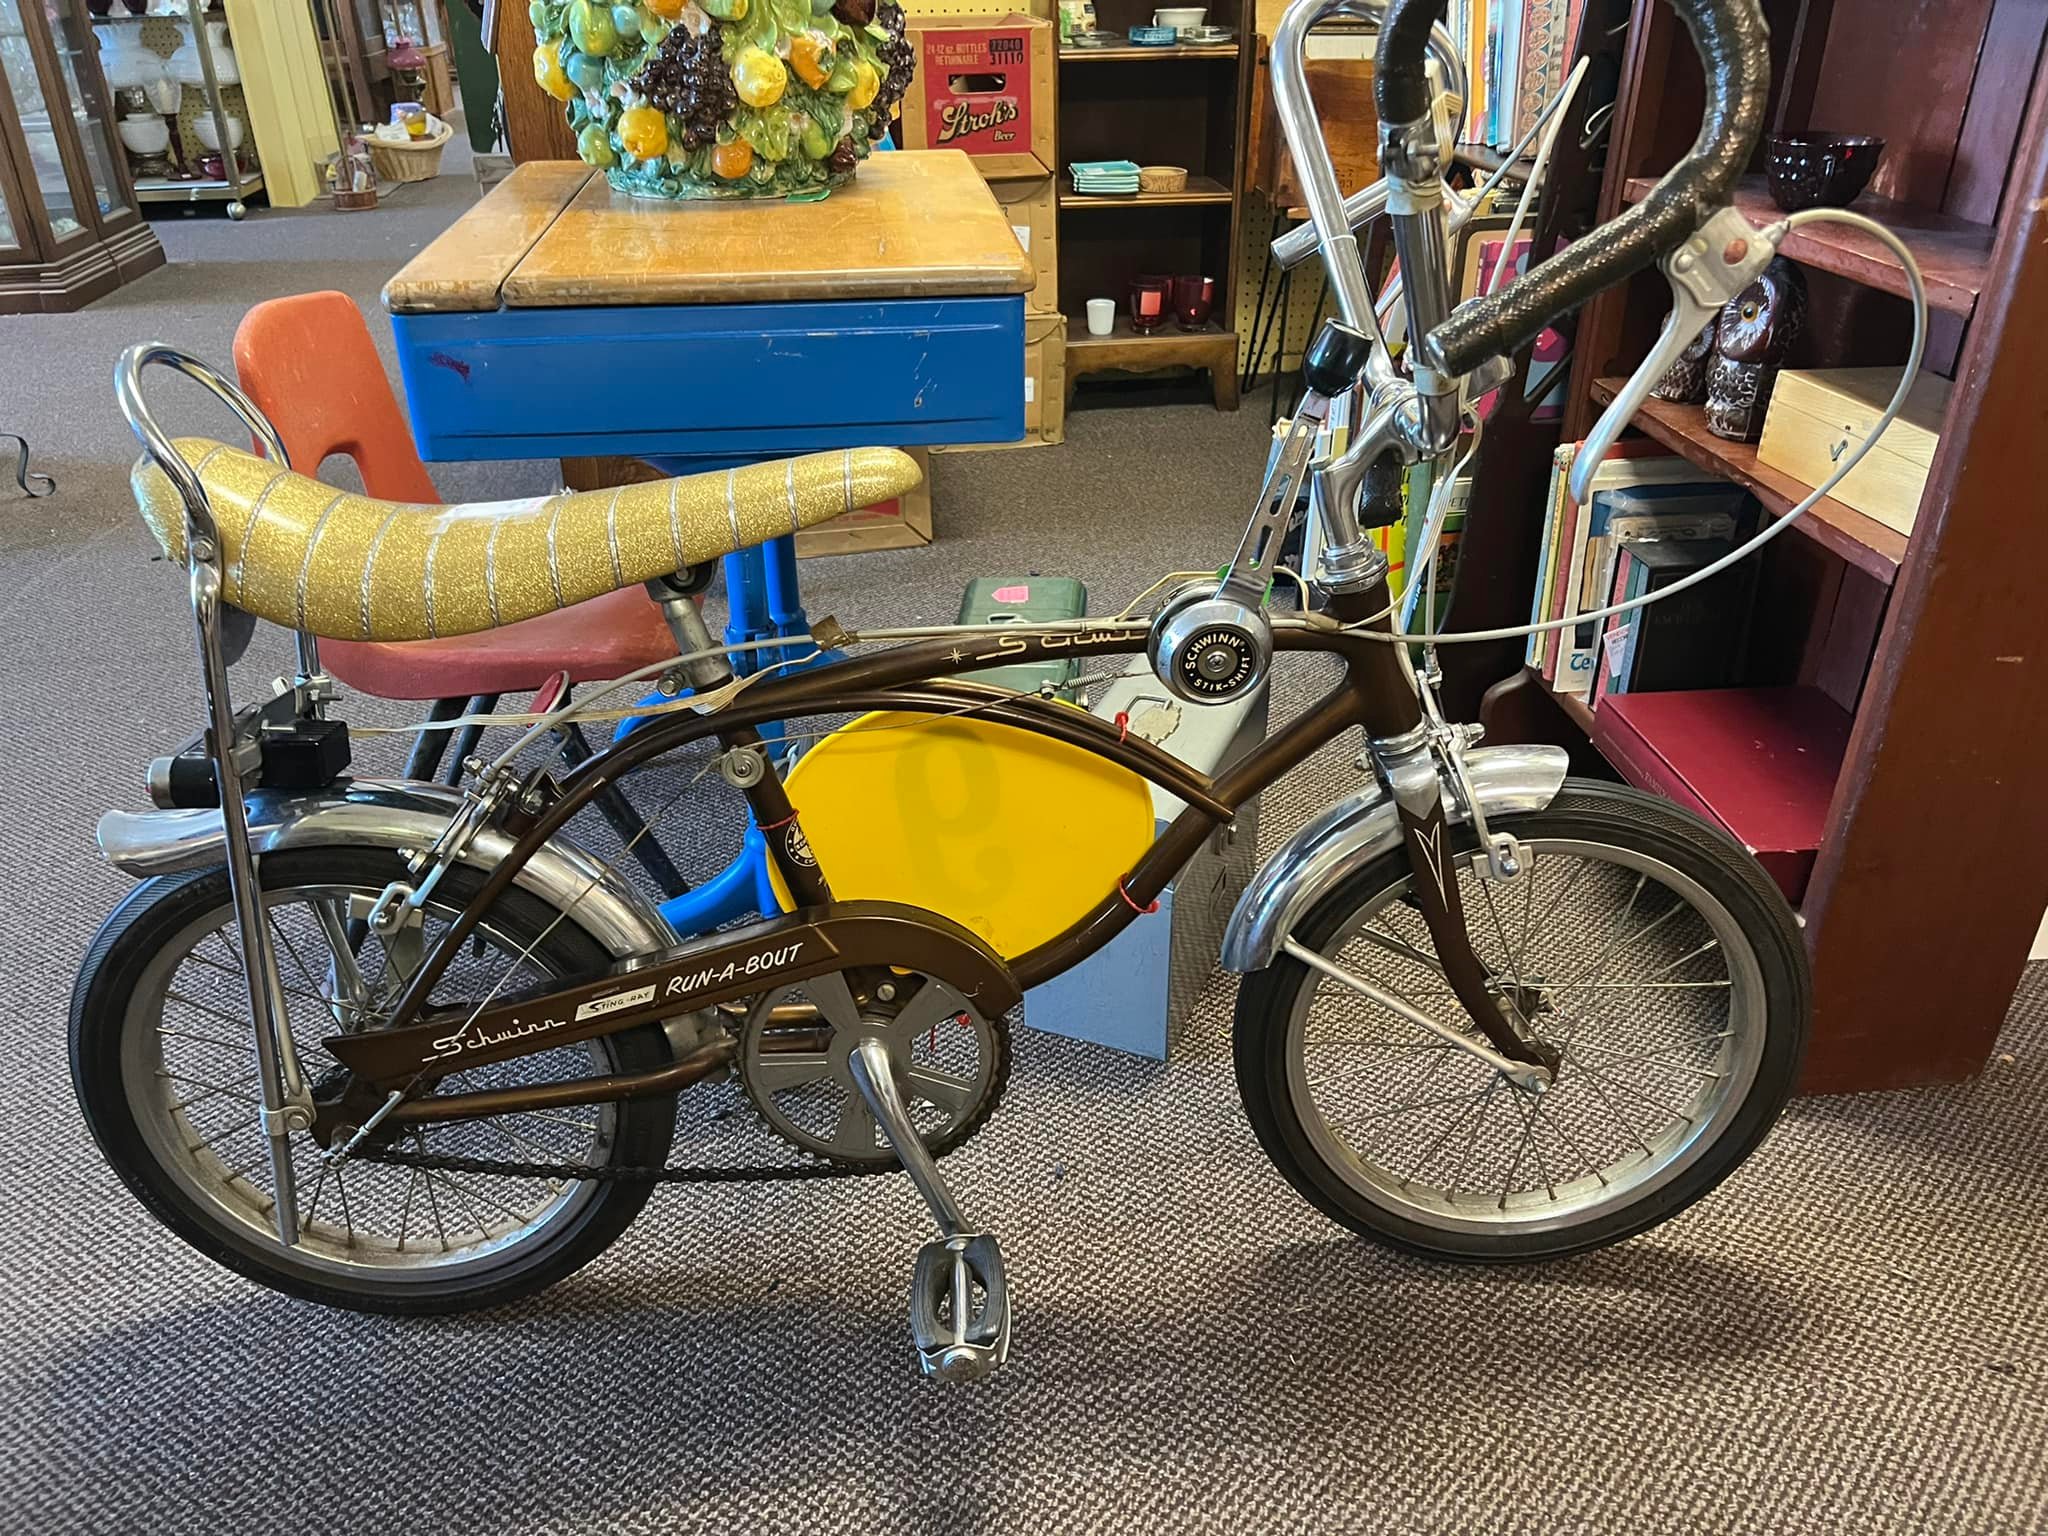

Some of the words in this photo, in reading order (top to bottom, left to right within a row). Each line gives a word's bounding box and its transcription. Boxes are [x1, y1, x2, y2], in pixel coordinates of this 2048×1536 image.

[956, 43, 987, 54] BOTTLES
[936, 98, 1018, 144] Stroh's
[993, 129, 1016, 142] Beer
[1194, 656, 1251, 692] STIK-SHIFT
[664, 943, 804, 997] RUN-A-BOUT
[586, 990, 651, 1014] STING-RAY
[421, 1017, 566, 1063] Schwinn
